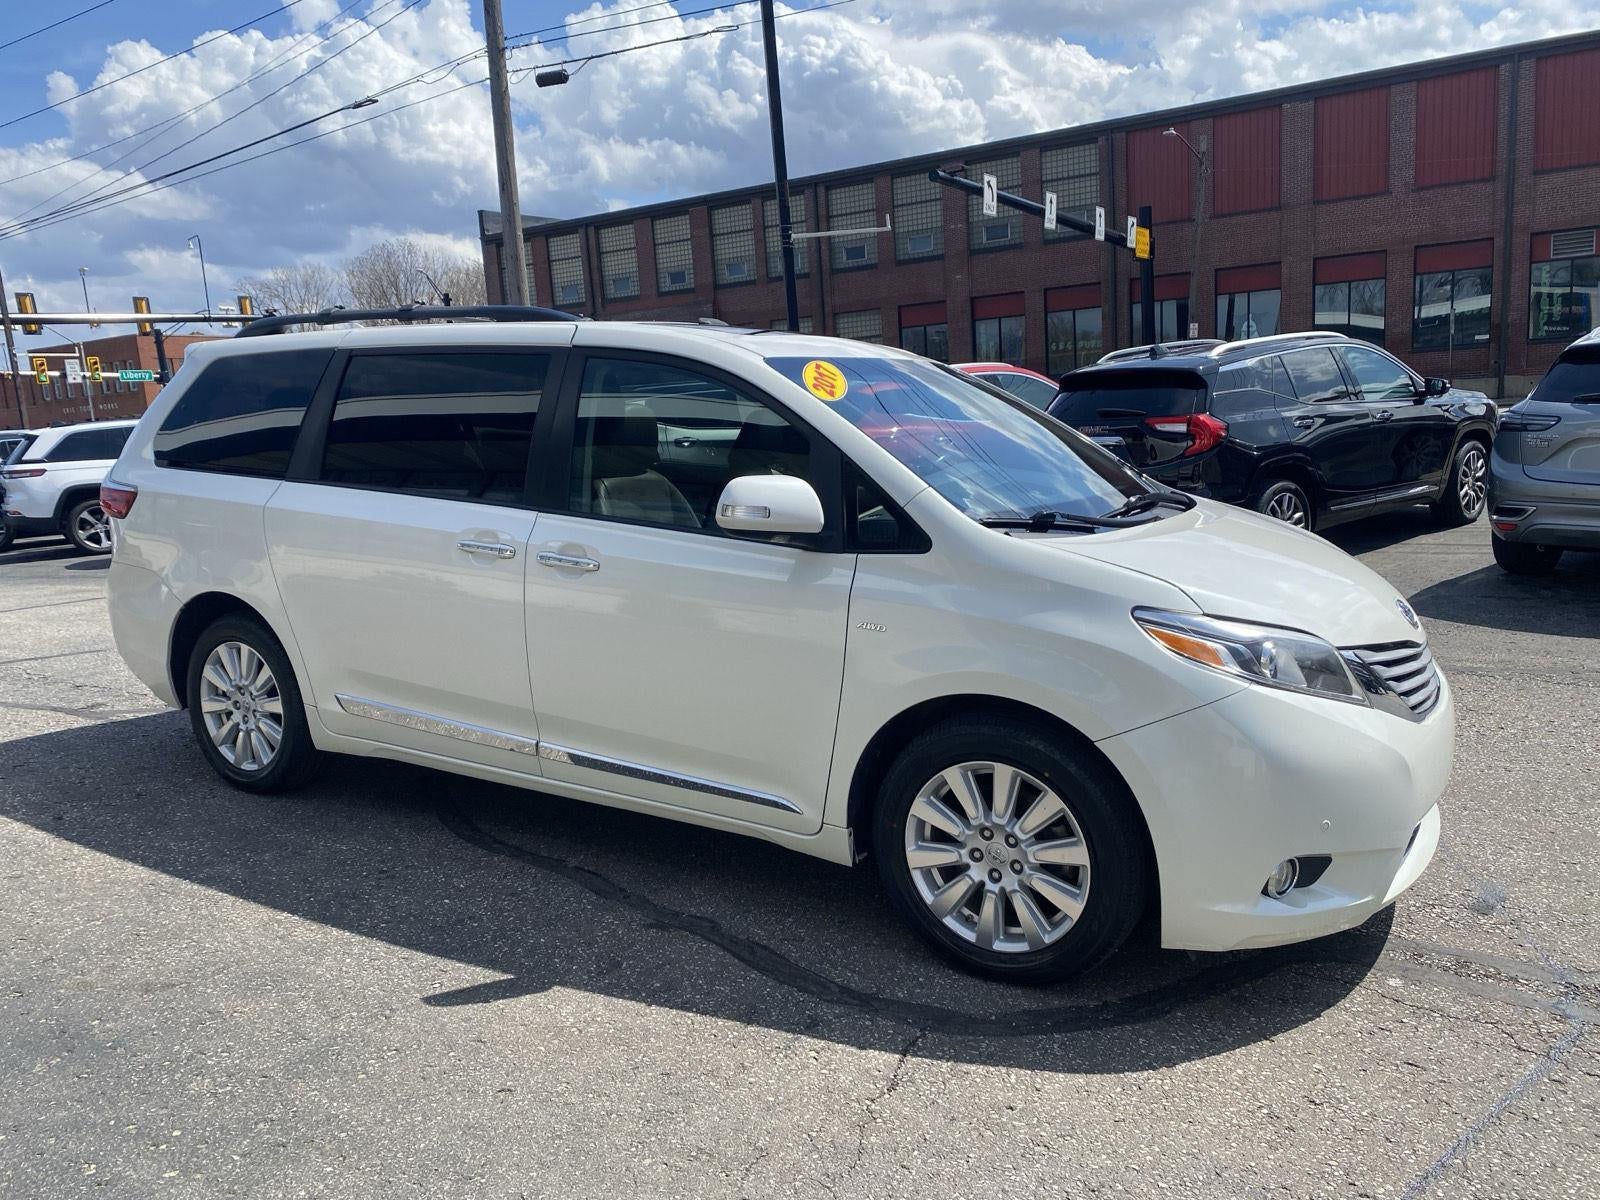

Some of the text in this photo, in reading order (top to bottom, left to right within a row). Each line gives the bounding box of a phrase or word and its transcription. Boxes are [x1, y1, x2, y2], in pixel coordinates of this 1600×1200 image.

[122, 371, 149, 380] Liberty
[812, 363, 837, 397] 2017
[99, 403, 119, 411] WORKS
[1079, 425, 1109, 433] GMC
[856, 622, 886, 632] AWD
